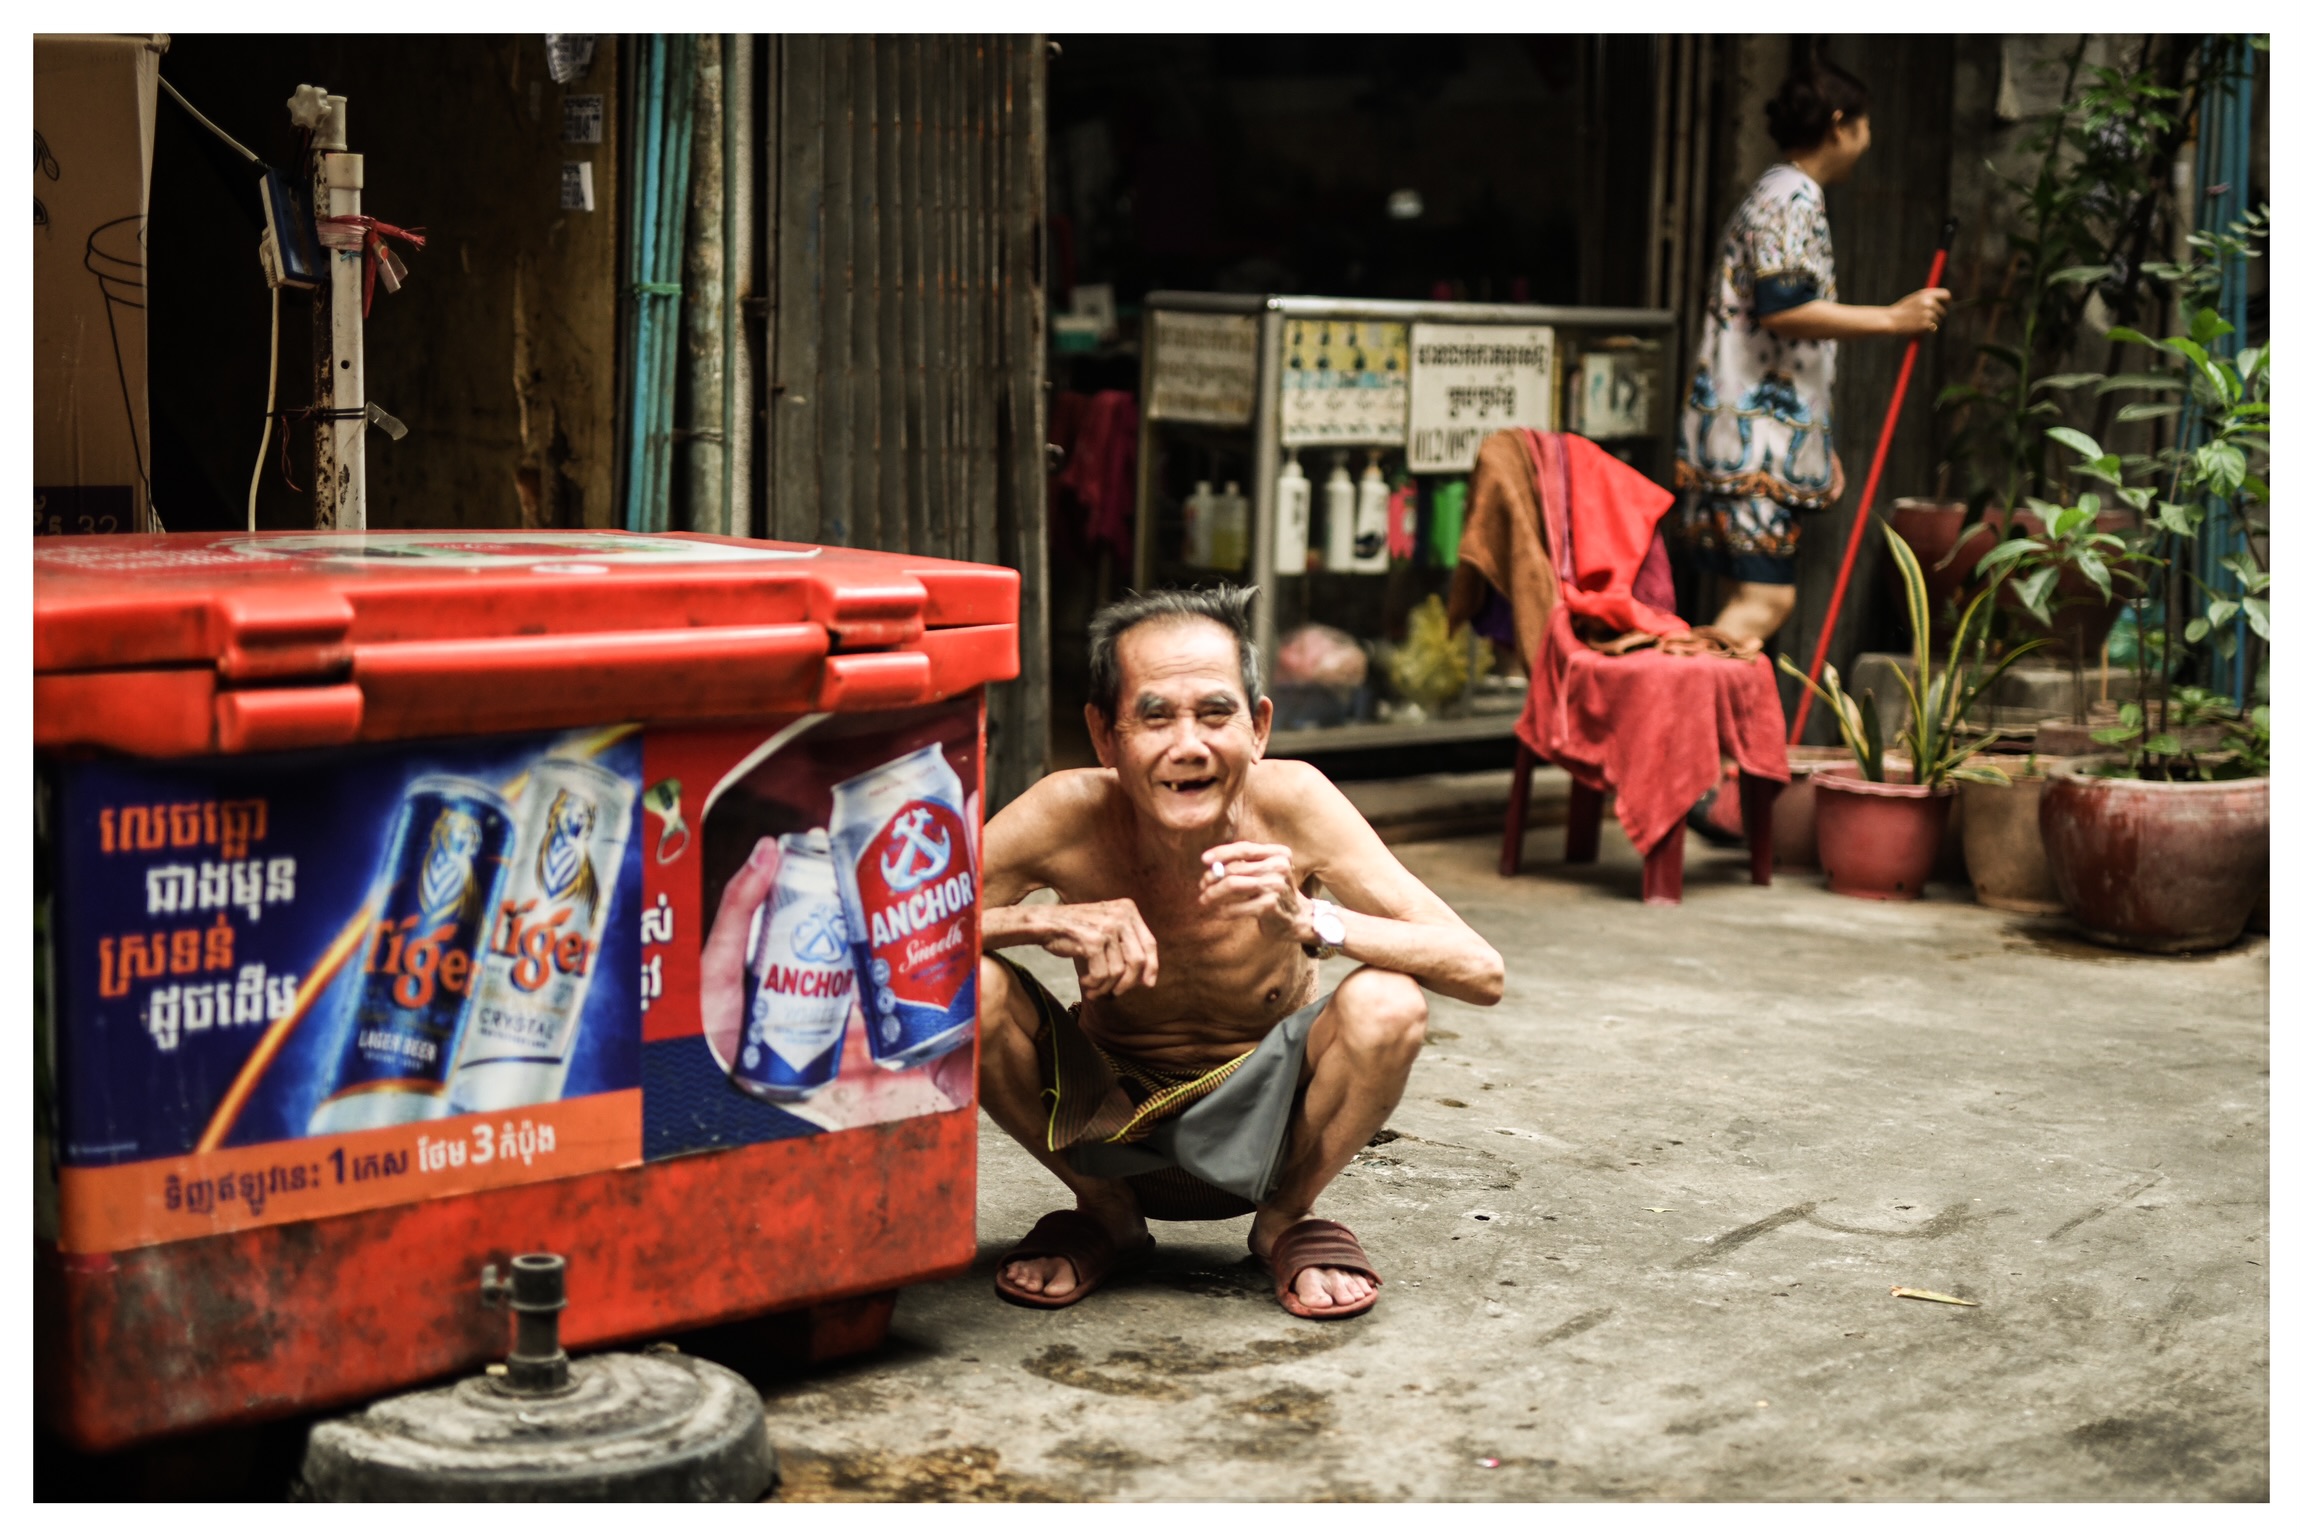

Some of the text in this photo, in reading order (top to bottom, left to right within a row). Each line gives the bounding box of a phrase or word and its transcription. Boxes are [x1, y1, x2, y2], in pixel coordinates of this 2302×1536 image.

[146, 857, 297, 922] ជាងមុន
[871, 871, 973, 948] ANCHOR
[99, 911, 234, 997] ស្រទន់
[149, 963, 298, 1050] ដូចដើម
[478, 1006, 555, 1040] CRYSTAL
